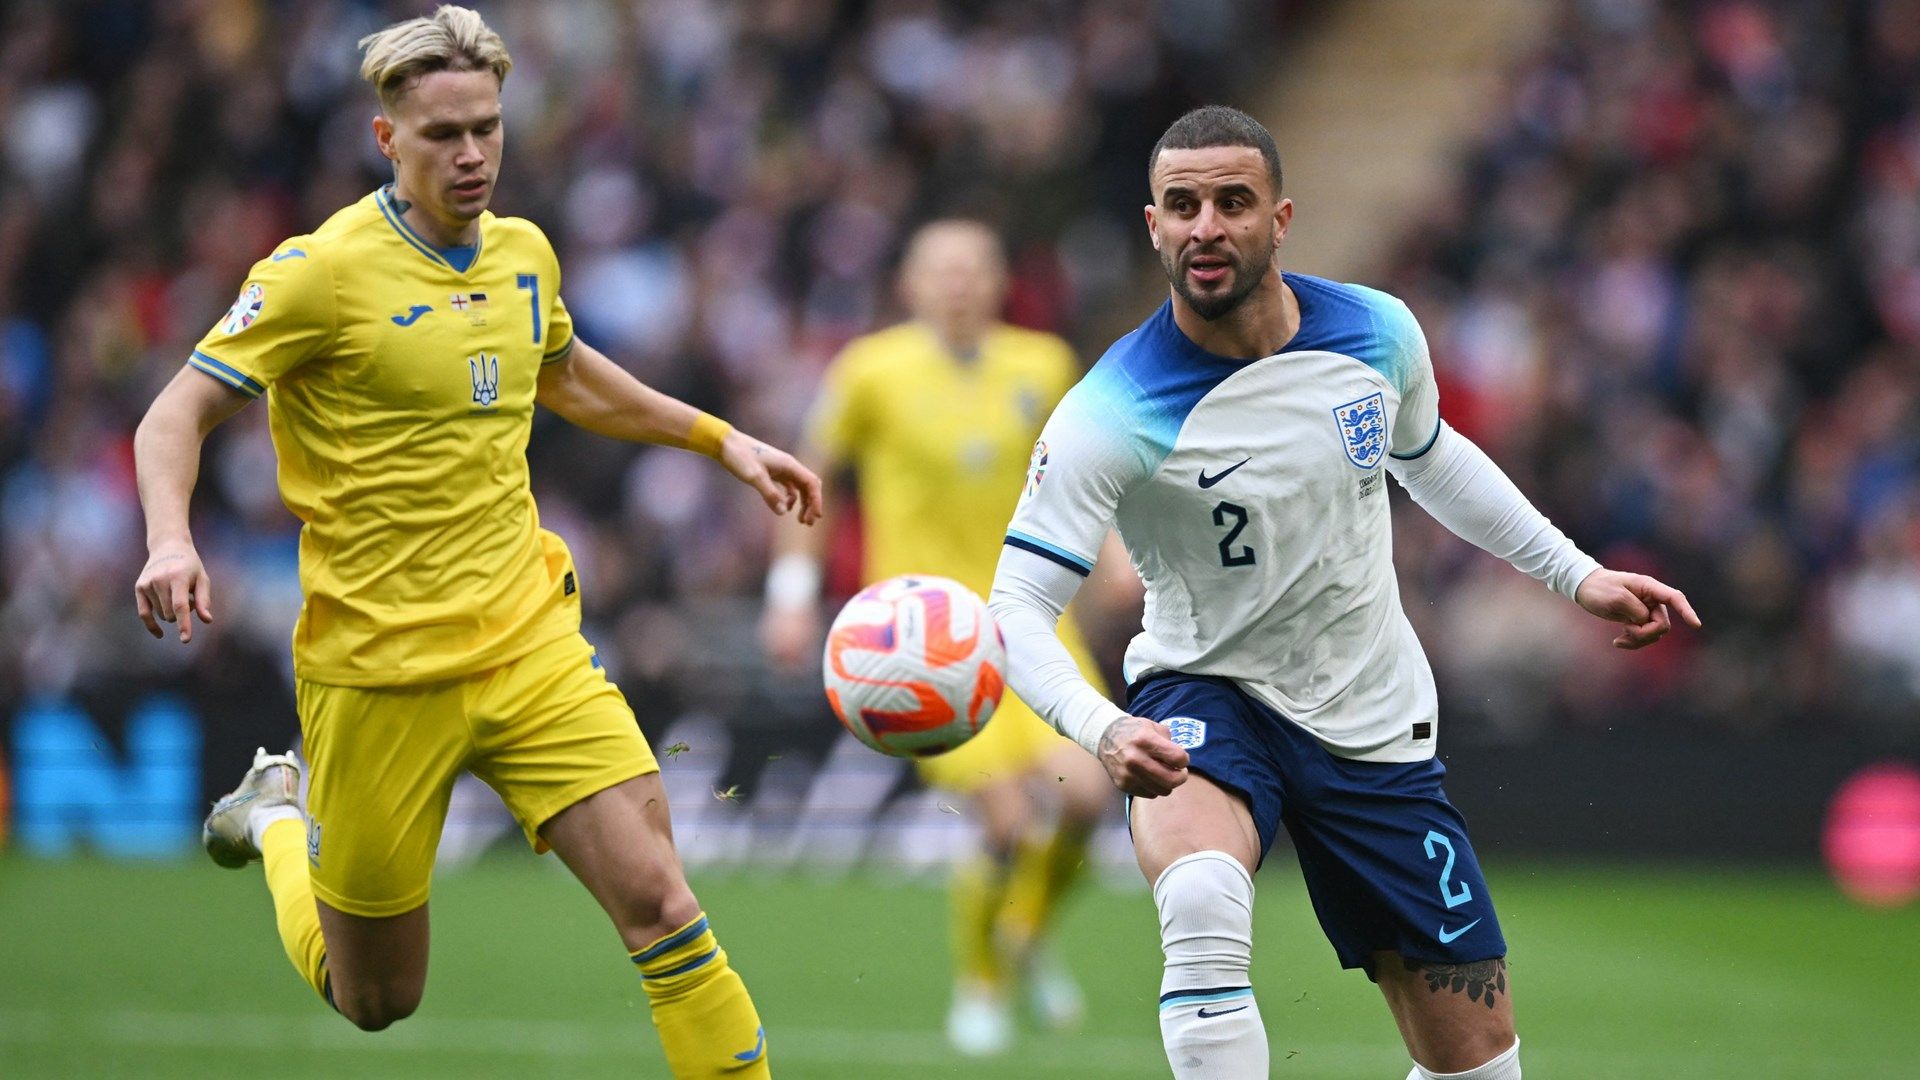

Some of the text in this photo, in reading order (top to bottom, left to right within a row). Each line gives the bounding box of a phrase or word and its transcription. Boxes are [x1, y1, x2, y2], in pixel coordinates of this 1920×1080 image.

[516, 275, 541, 343] 7
[1212, 501, 1256, 567] 2
[1423, 830, 1472, 909] 2
